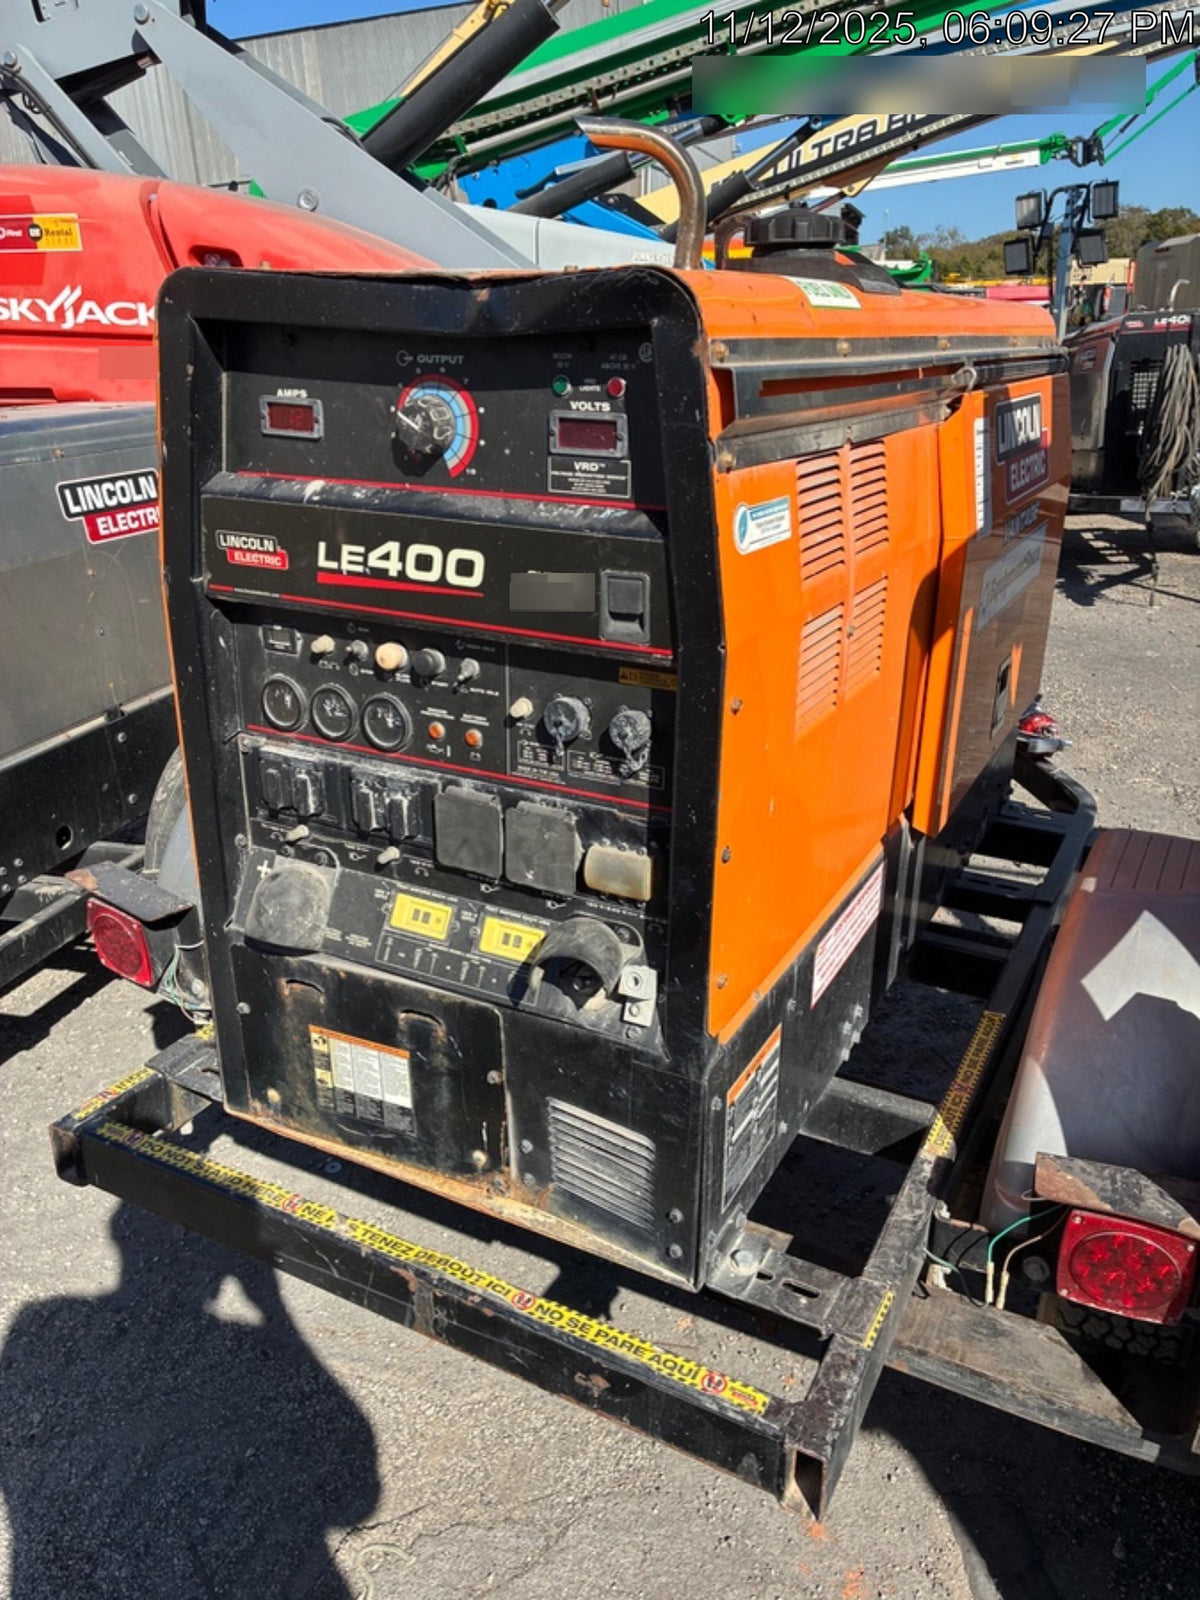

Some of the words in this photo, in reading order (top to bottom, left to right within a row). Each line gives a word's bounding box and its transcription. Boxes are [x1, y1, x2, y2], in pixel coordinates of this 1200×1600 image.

[417, 354, 465, 364] OUTPUT
[276, 388, 309, 399] AMPS
[569, 401, 612, 412] VOLTS
[996, 403, 1041, 453] LINCOLN
[63, 474, 158, 515] LINCOLN
[219, 534, 275, 552] LINCOLN
[233, 550, 282, 566] ELECTRIC
[317, 540, 485, 588] LE400
[140, 1140, 163, 1154] DO
[163, 1149, 192, 1167] NOT
[301, 1204, 326, 1219] NE
[360, 1227, 415, 1257] TENEZ
[414, 1249, 486, 1286] DEBOUT
[485, 1280, 511, 1298] ICI
[534, 1303, 564, 1323] NO
[566, 1315, 595, 1335] SE
[594, 1328, 647, 1358] PARE
